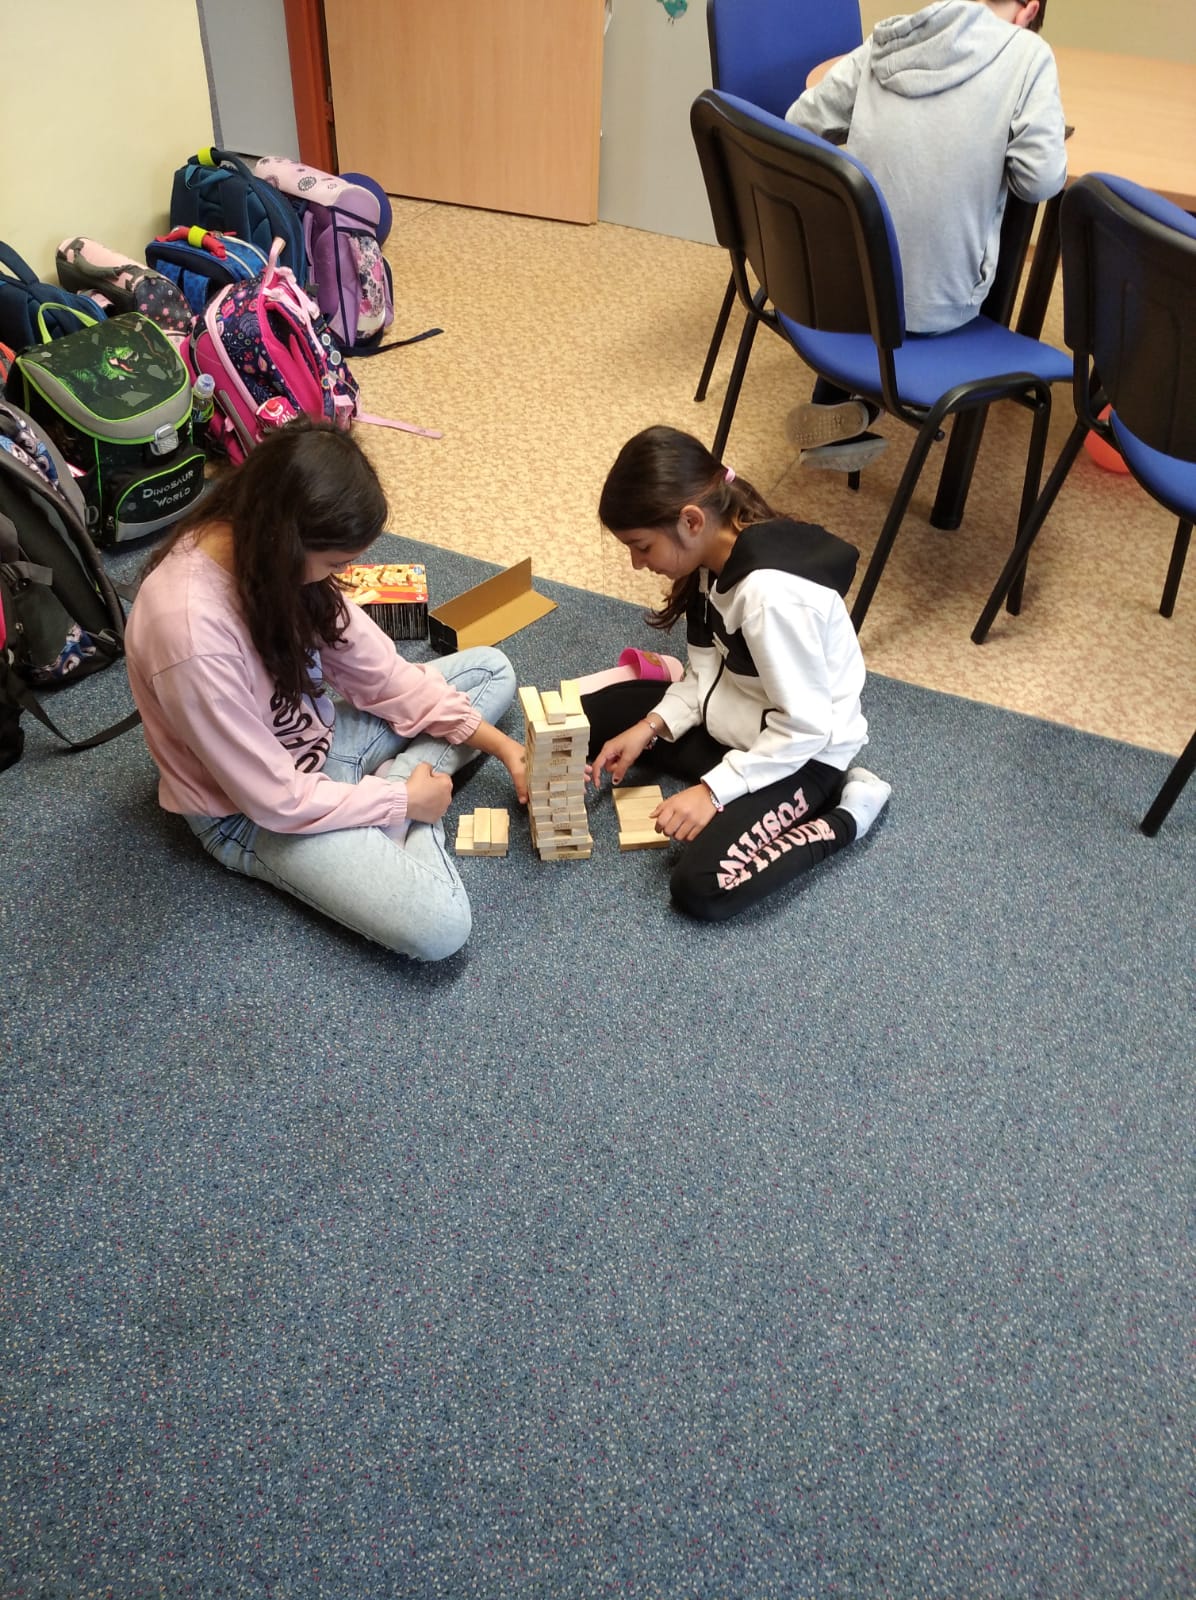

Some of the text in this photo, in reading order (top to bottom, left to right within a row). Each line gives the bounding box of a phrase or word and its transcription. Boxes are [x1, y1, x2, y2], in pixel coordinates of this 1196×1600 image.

[143, 470, 194, 498] DINOSAUR
[153, 487, 191, 506] WORLD
[724, 818, 837, 890] TITUDE
